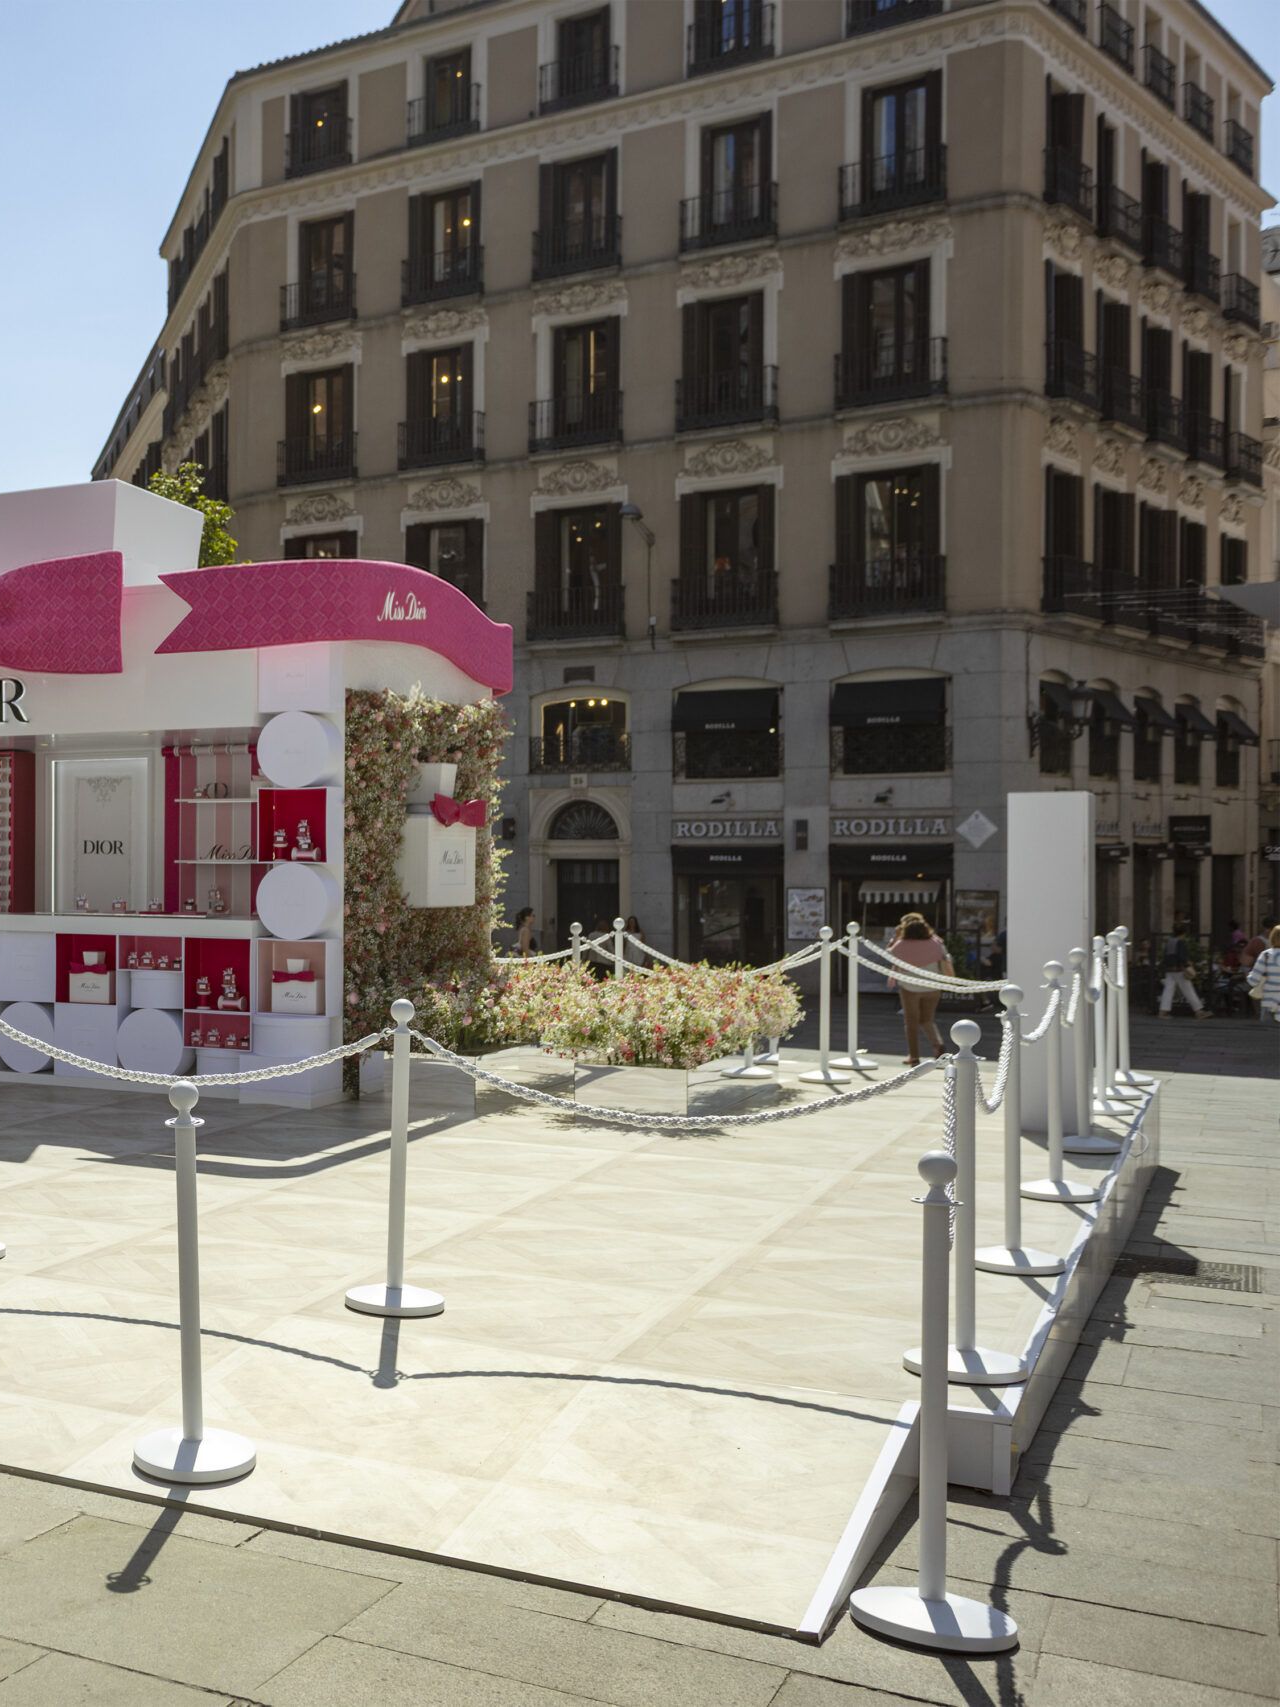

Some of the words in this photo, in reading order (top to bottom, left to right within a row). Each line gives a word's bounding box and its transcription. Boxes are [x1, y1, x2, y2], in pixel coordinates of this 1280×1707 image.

[377, 592, 405, 621] Miss
[406, 592, 427, 621] Dior
[675, 820, 780, 838] RODILLA
[833, 818, 948, 837] RODILLA
[83, 840, 124, 855] DIOR
[199, 844, 236, 860] Miss
